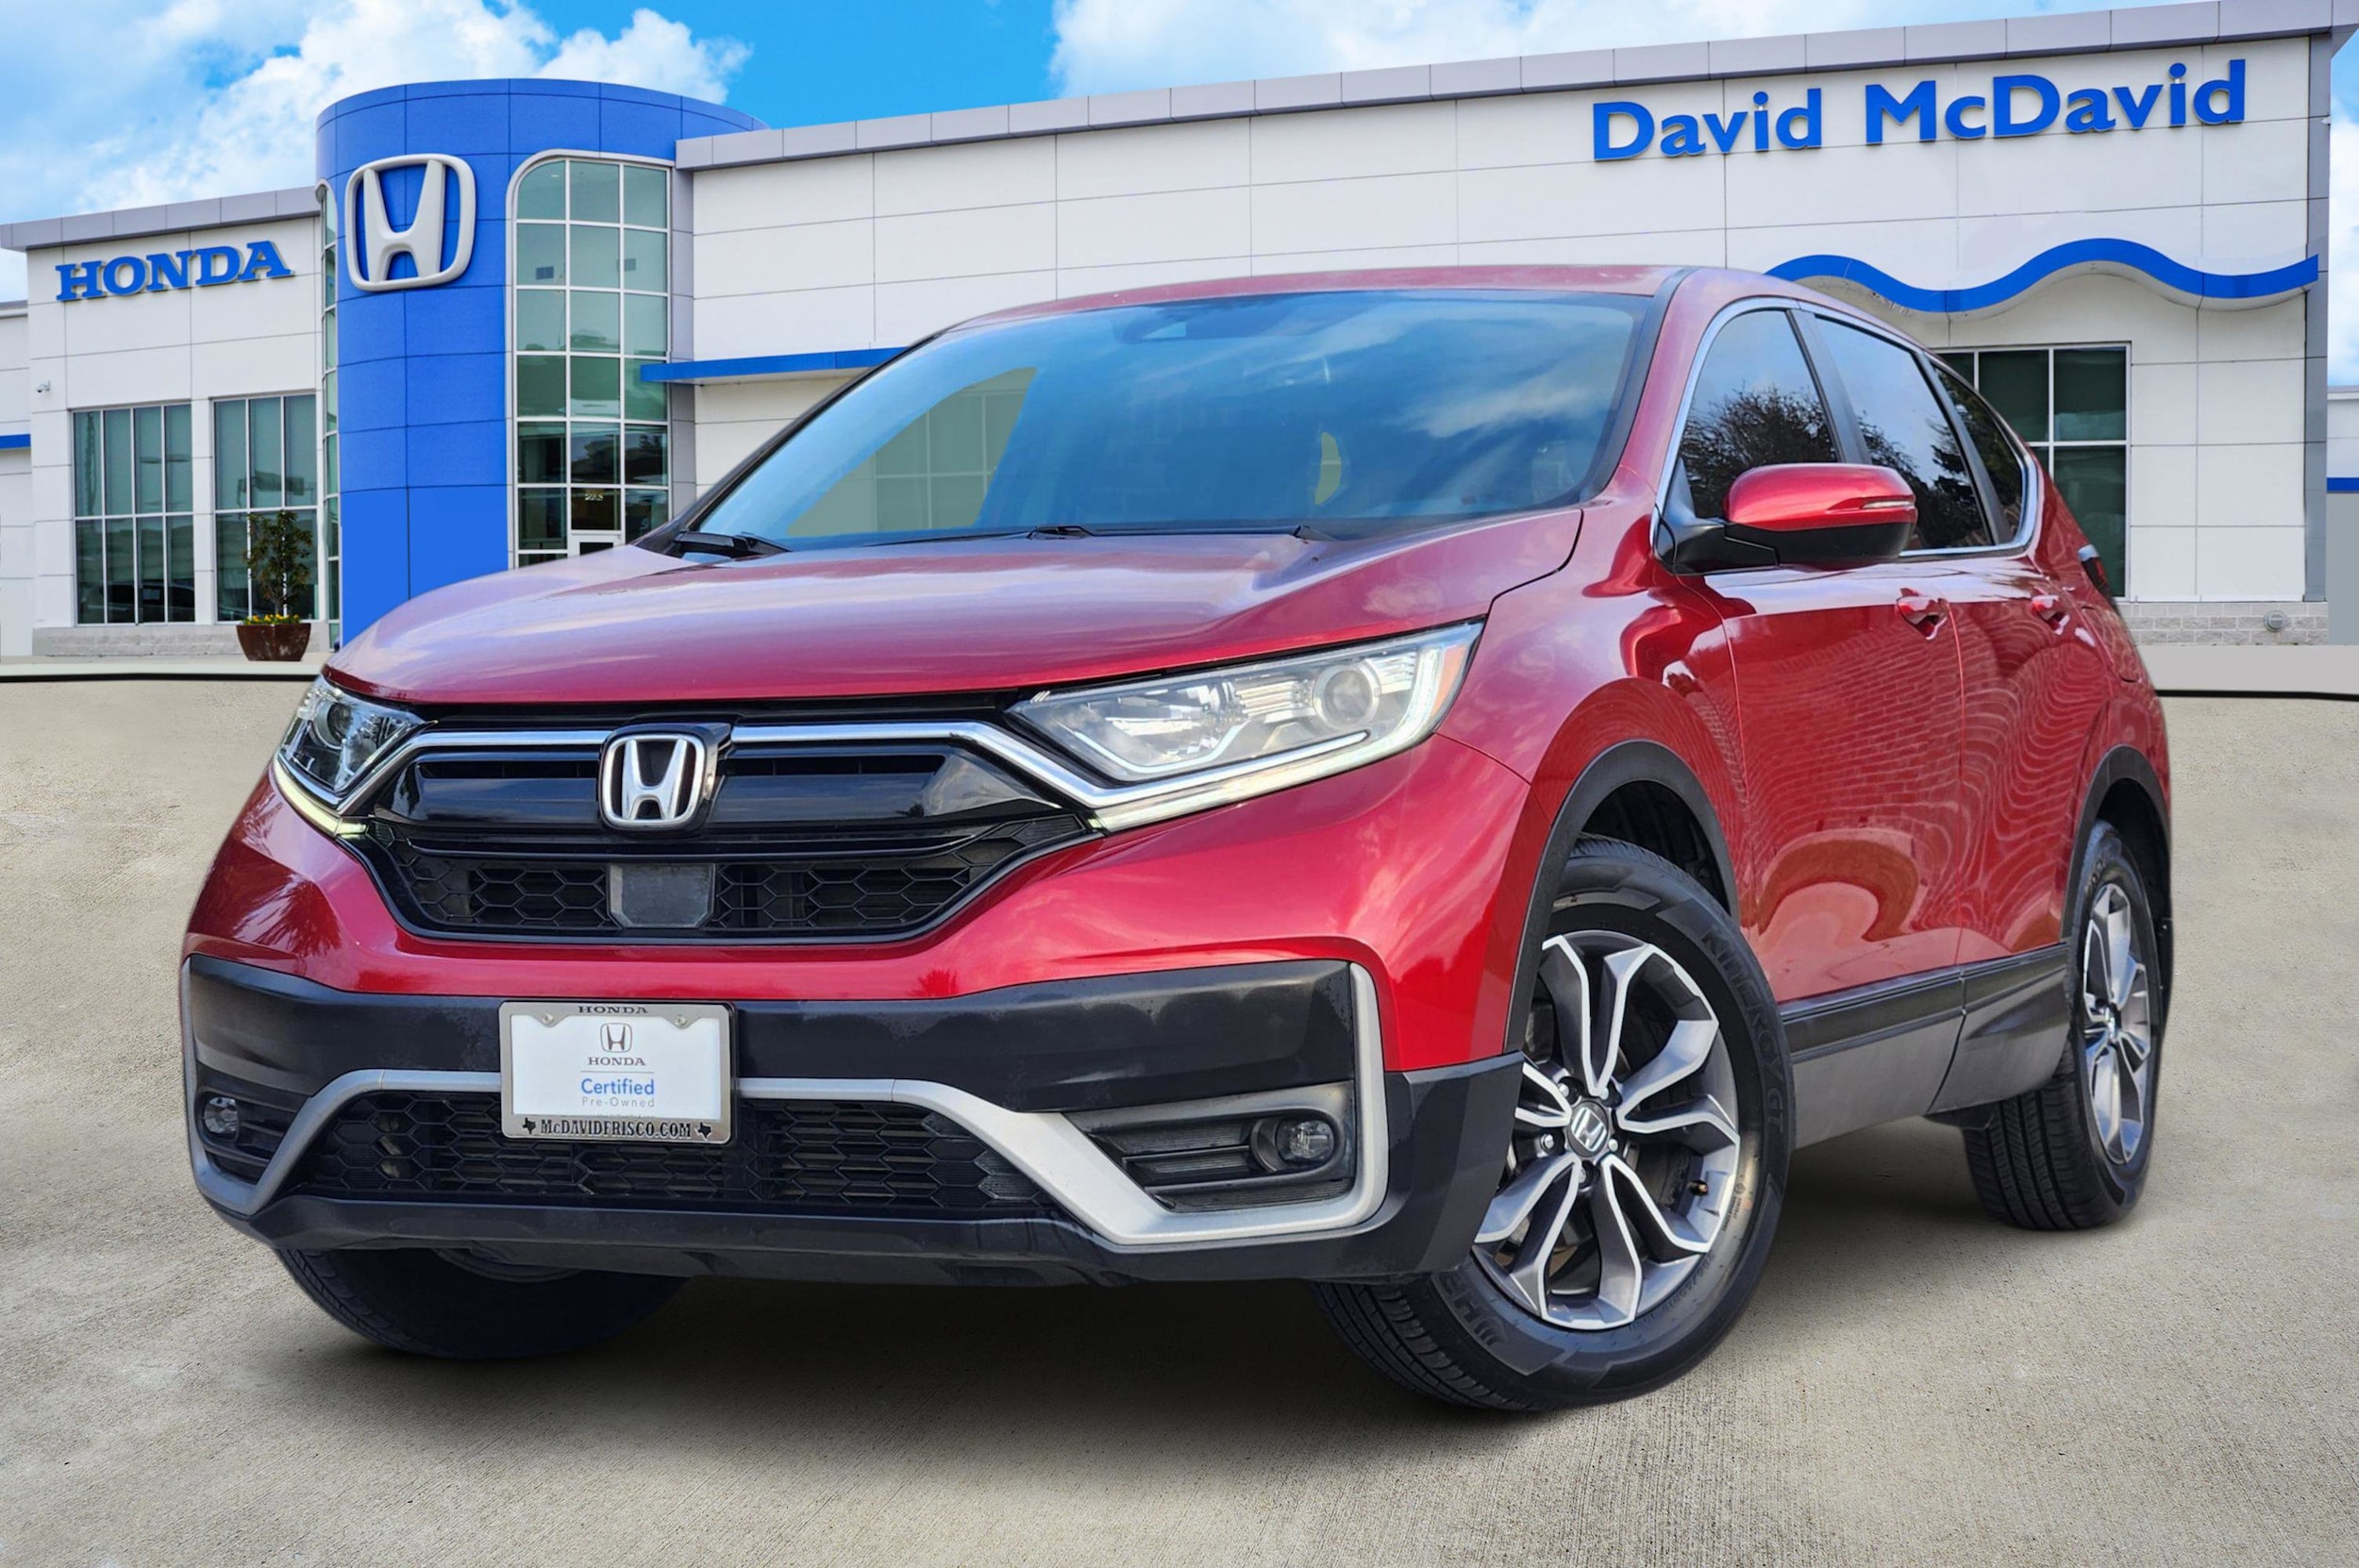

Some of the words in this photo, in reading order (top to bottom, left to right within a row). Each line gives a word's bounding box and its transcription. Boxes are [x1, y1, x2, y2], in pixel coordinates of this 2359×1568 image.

[1593, 87, 1822, 162] David
[1864, 58, 2247, 144] McDavid
[56, 241, 293, 302] HONDA
[577, 1006, 648, 1014] HONDA
[588, 1056, 646, 1067] HONDA
[580, 1077, 655, 1095] Certified
[581, 1096, 656, 1109] Pre-Owned
[541, 1119, 692, 1139] McDAVIDFRISCO.COM
